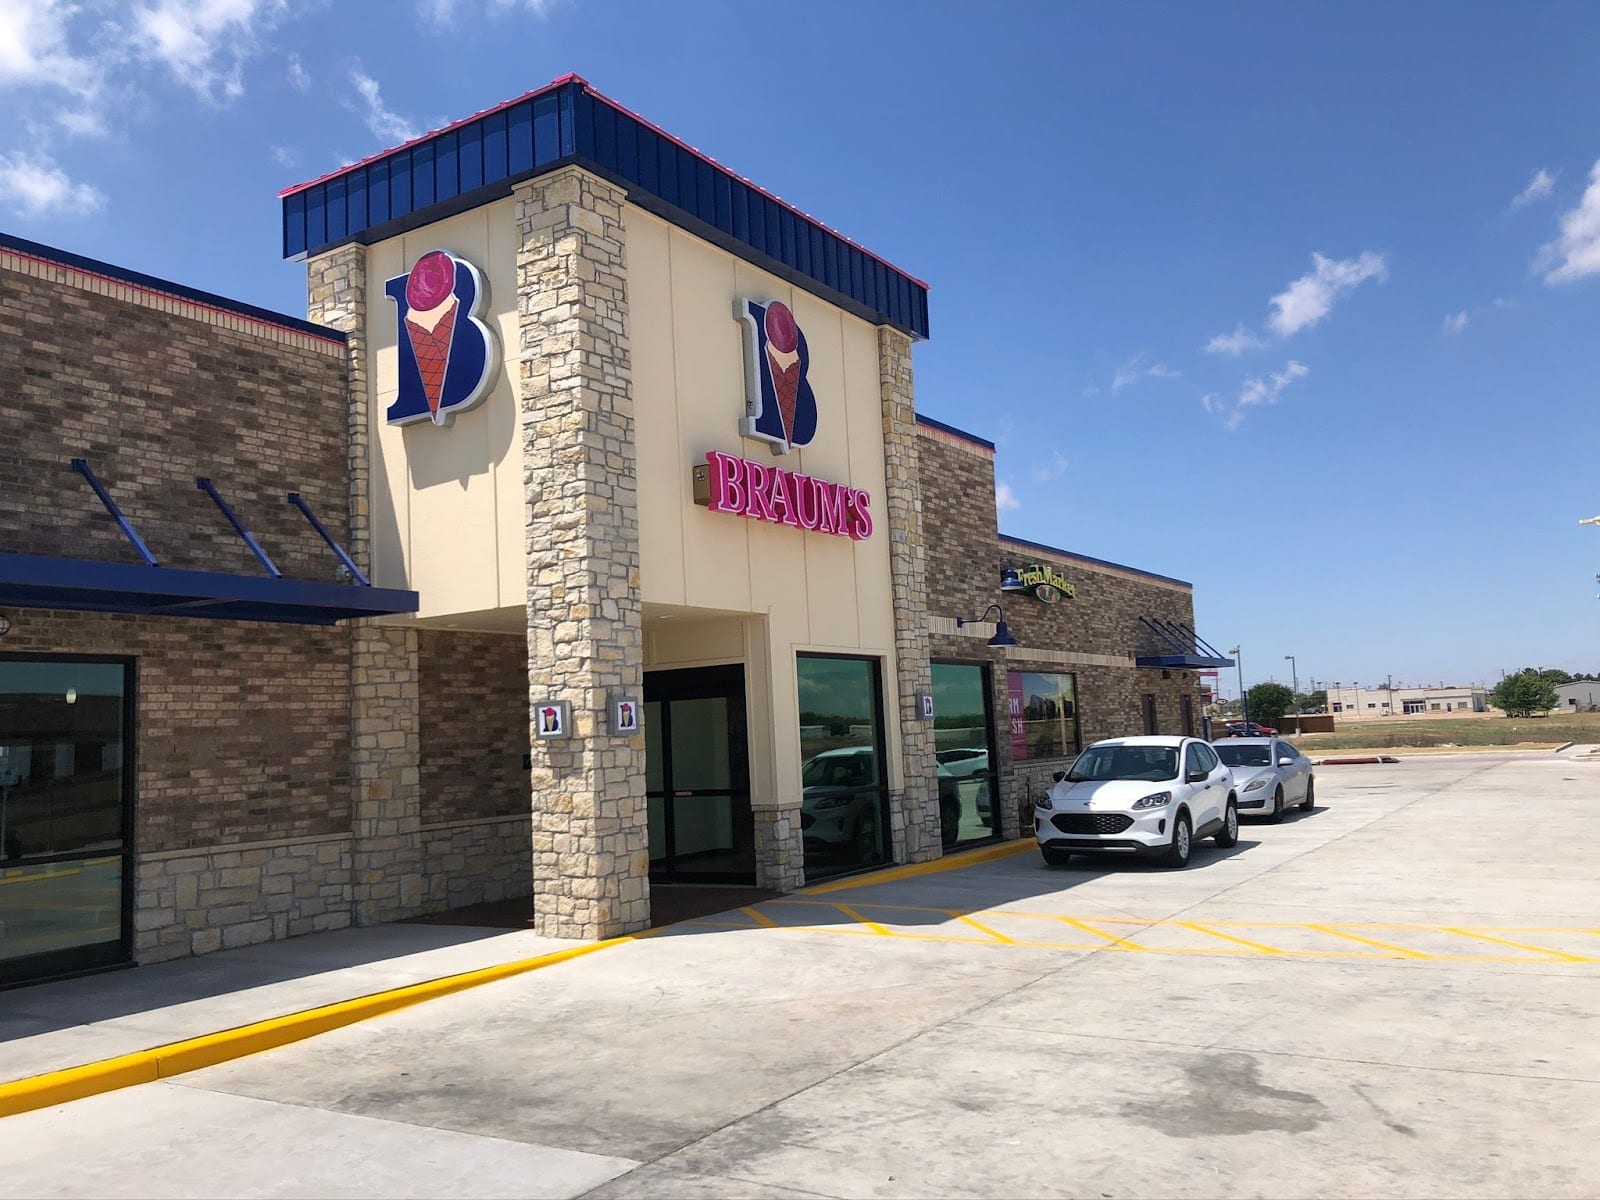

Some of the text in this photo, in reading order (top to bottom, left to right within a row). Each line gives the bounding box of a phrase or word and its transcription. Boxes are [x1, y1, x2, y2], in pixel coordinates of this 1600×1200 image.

[706, 450, 873, 541] BRAUM'S
[1015, 564, 1077, 599] Fresh Market
